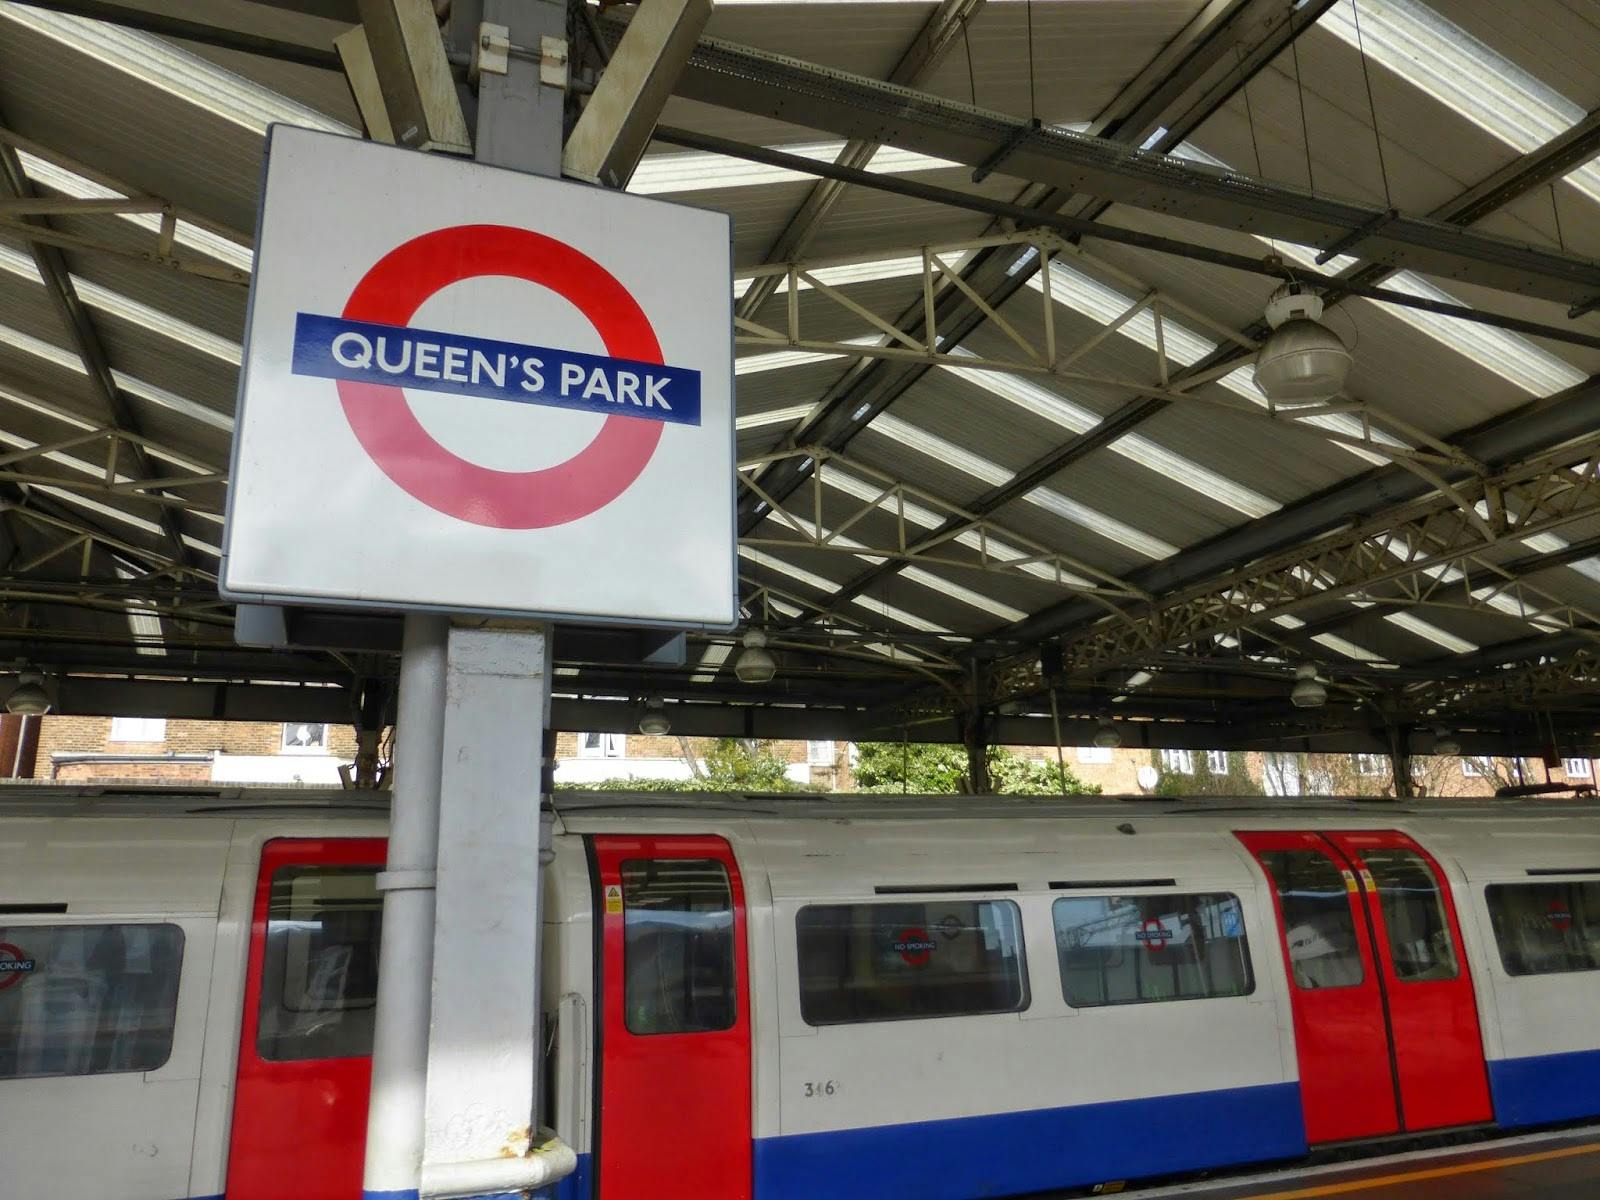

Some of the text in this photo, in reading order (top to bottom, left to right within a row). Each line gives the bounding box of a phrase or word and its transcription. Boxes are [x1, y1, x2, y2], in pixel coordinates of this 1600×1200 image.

[331, 332, 673, 411] QUEEN'S PARK
[894, 943, 906, 951] NO
